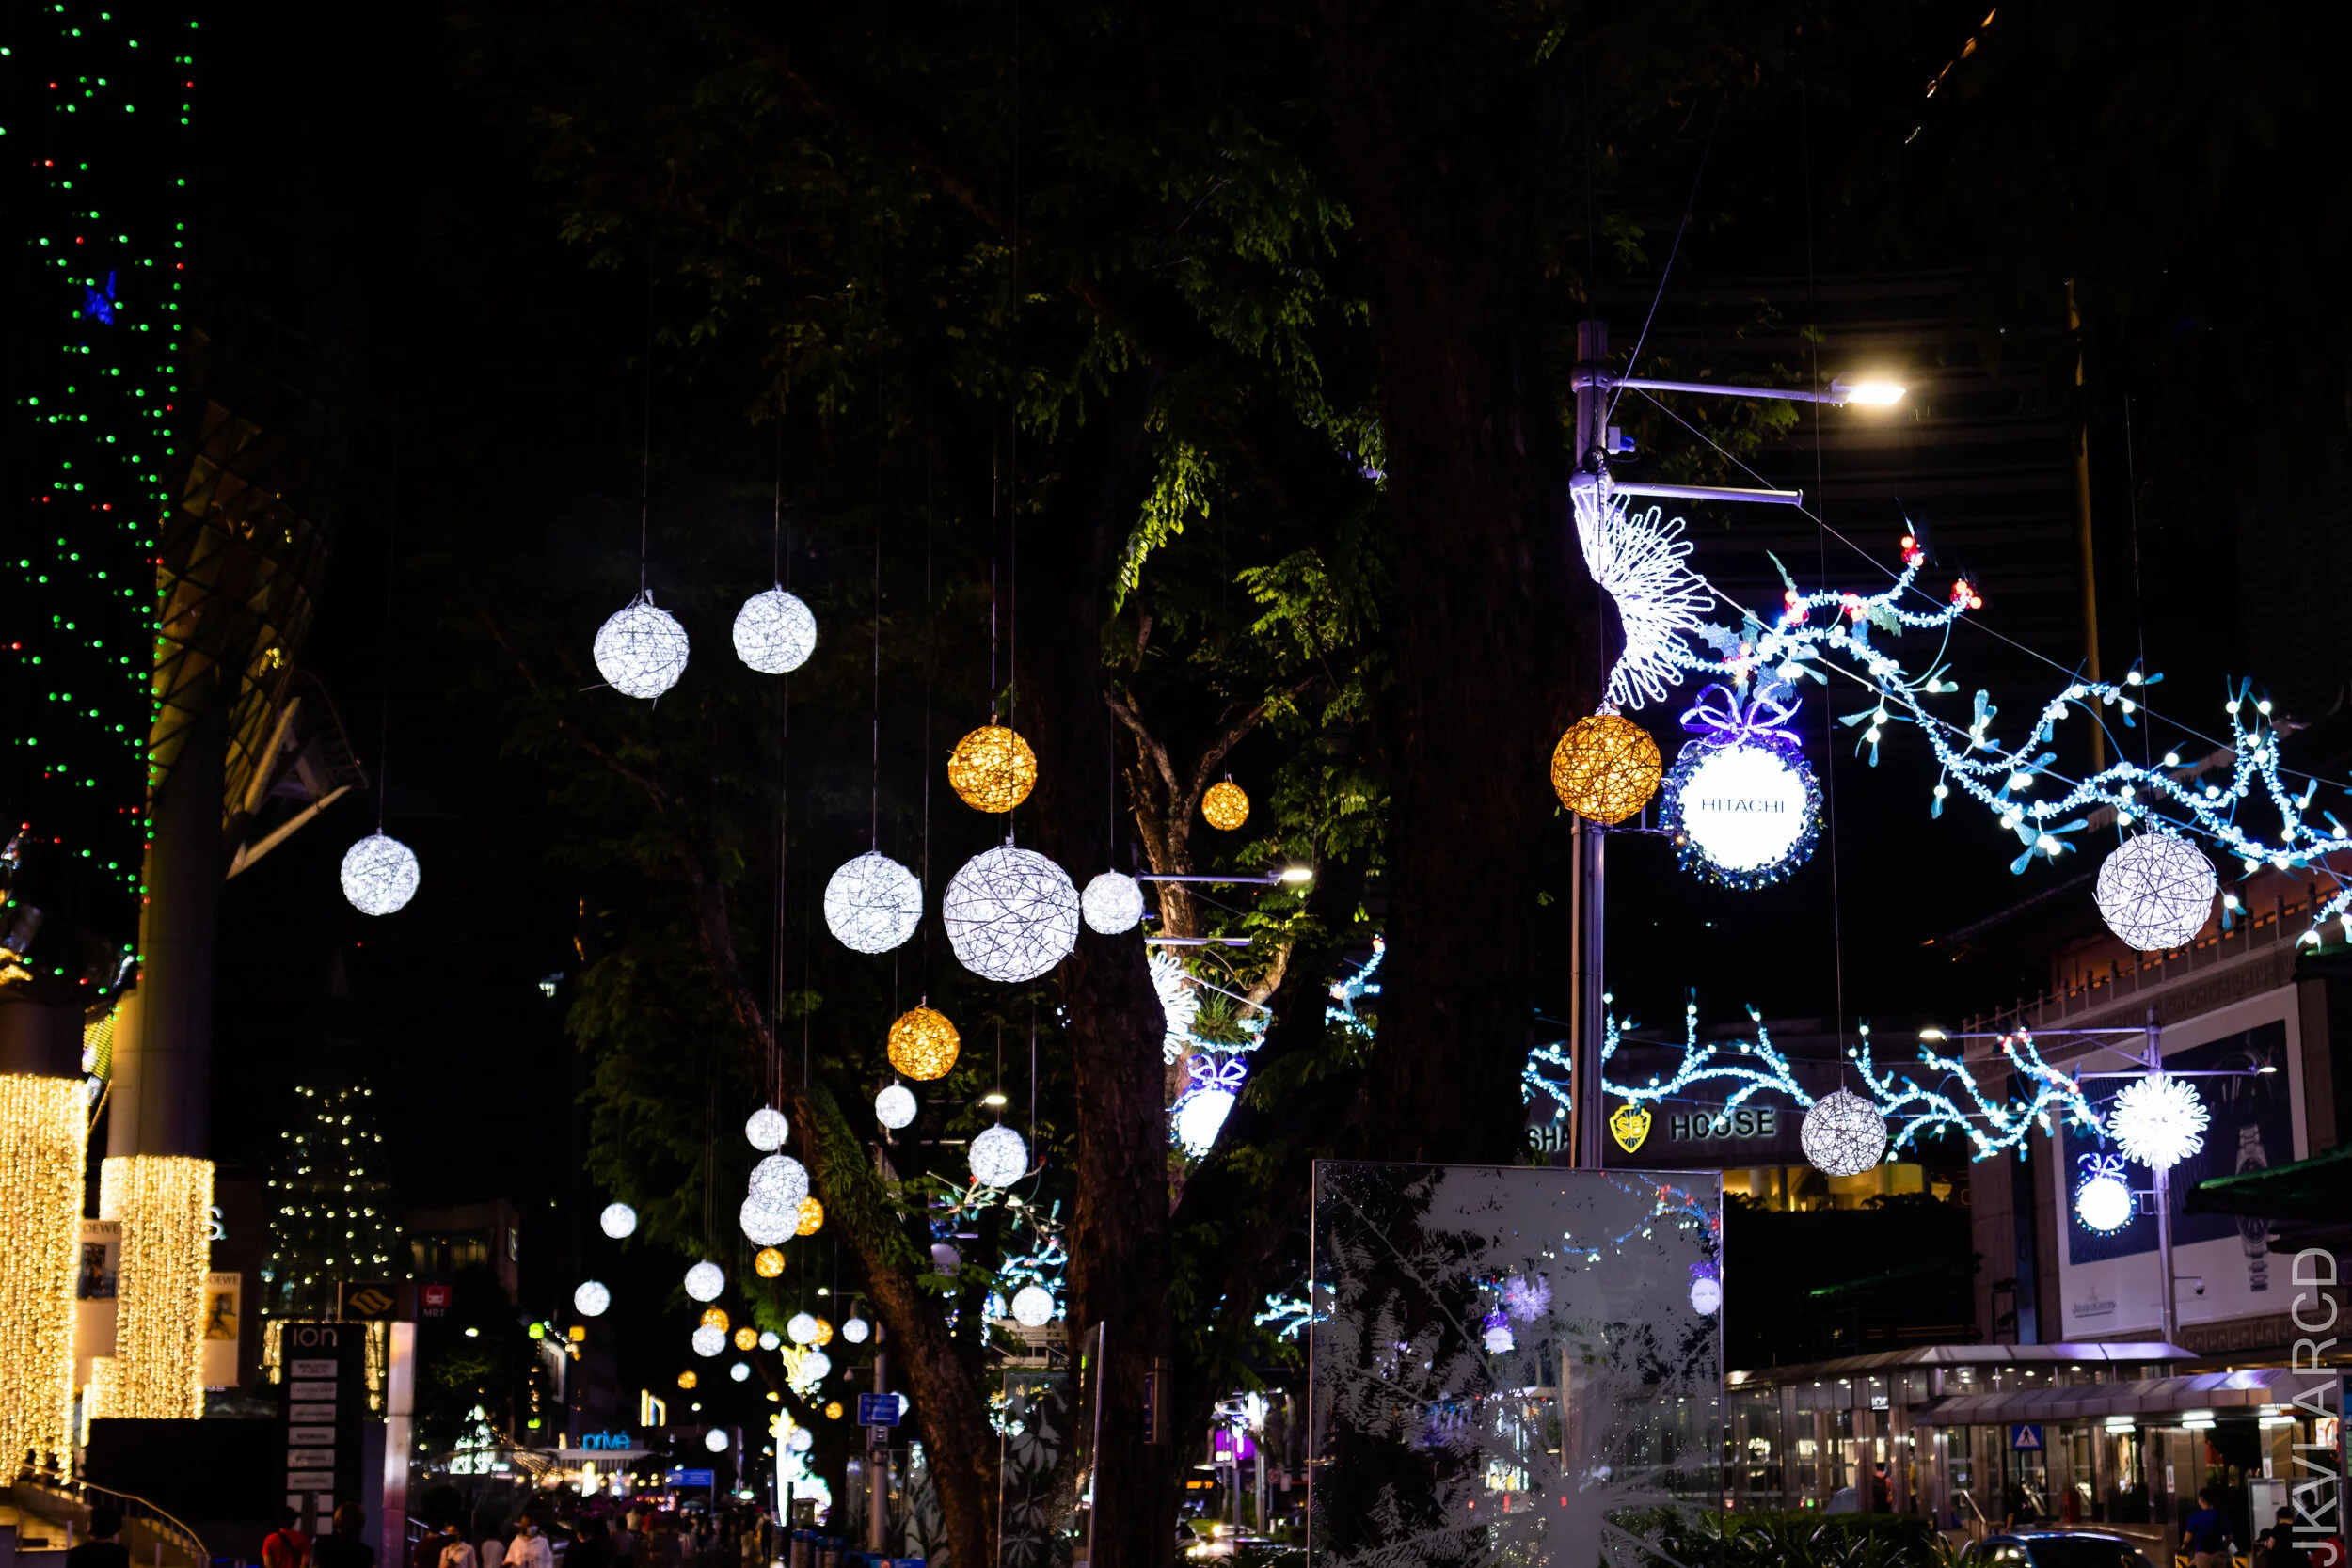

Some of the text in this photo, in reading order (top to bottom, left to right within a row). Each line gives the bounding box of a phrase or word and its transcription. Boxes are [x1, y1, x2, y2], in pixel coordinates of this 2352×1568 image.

[1701, 798, 1784, 813] HITACHI
[1529, 1110, 1775, 1151] SHA SB HOUSE
[83, 1223, 119, 1235] OEWE
[208, 1275, 239, 1286] OEWE
[422, 1308, 445, 1318] MRT
[582, 1429, 631, 1452] privé
